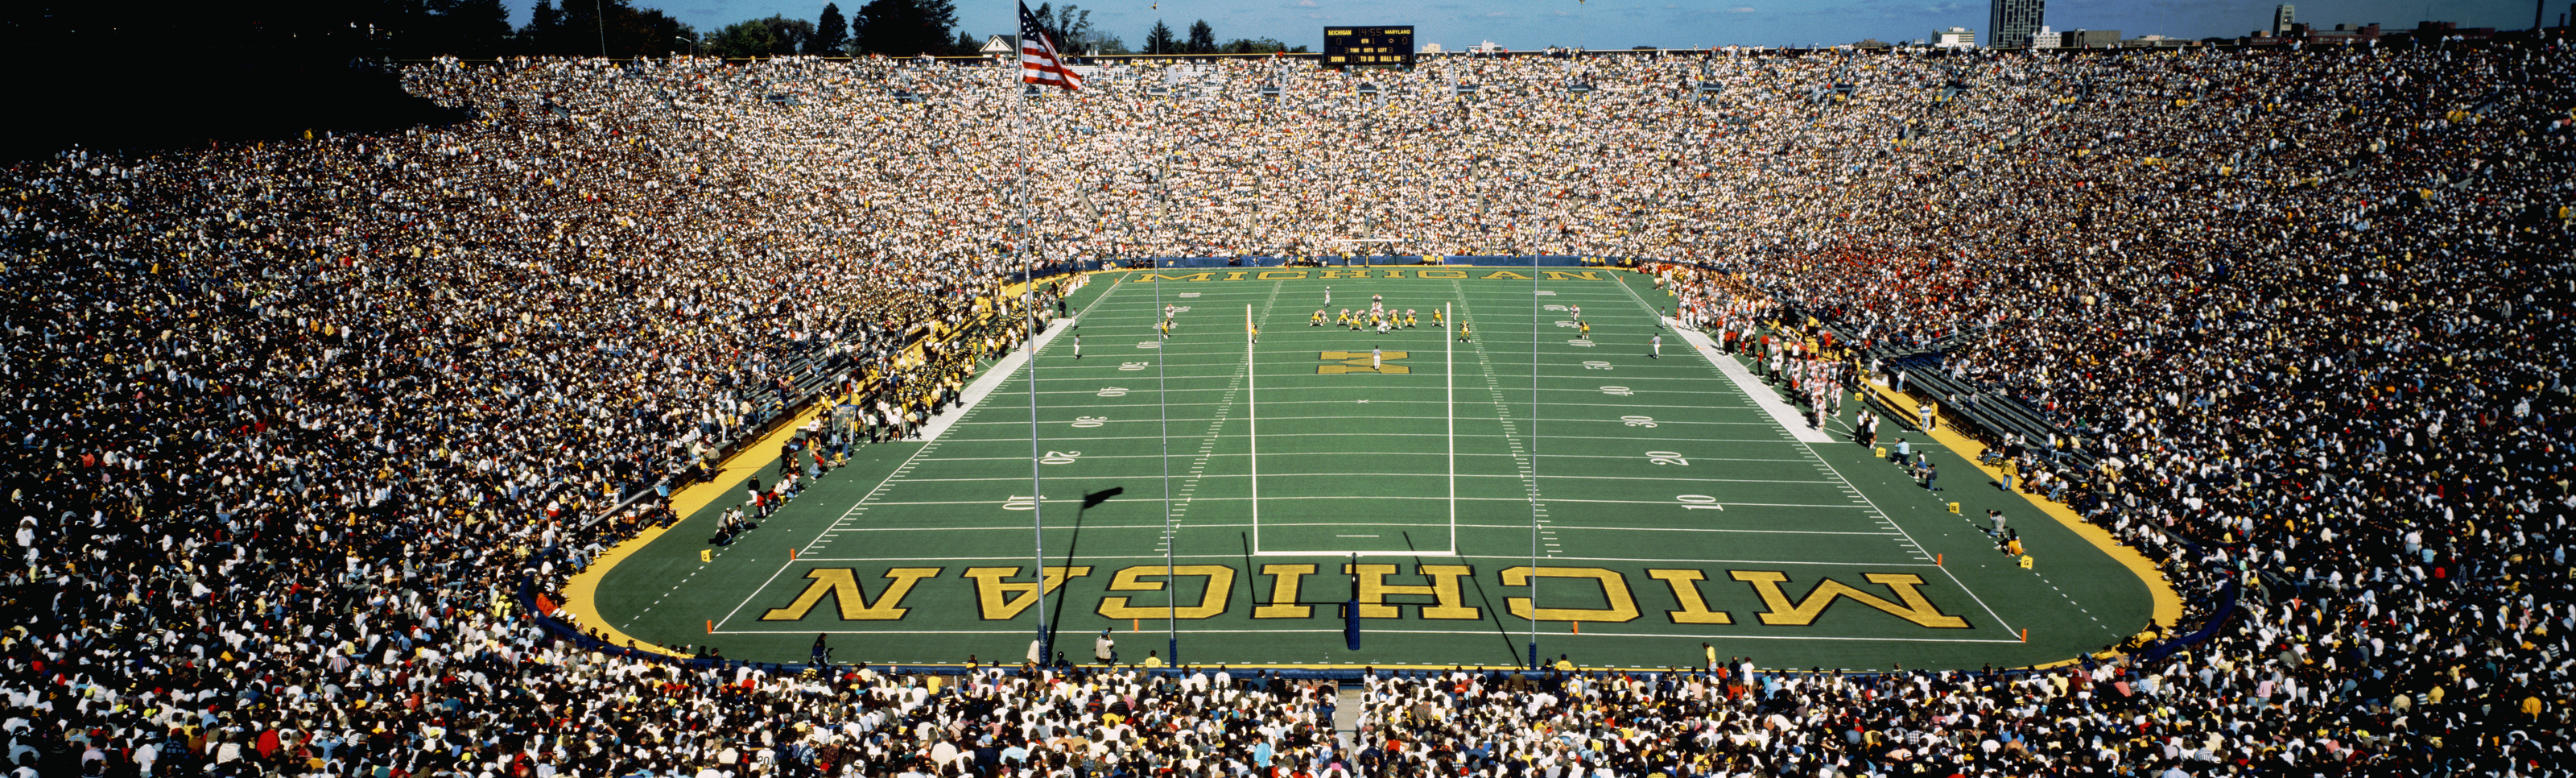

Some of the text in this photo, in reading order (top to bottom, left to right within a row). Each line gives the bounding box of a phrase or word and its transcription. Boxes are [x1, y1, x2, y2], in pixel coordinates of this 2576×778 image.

[1357, 28, 1382, 36] 14:55
[1336, 37, 1342, 45] 0
[1402, 36, 1408, 44] 0
[1350, 55, 1360, 64] 10
[1132, 270, 1601, 283] MICHIGAN
[1118, 362, 1149, 370] 50
[1583, 361, 1614, 370] 50
[1096, 387, 1129, 397] 40
[1600, 386, 1634, 397] 40
[1071, 416, 1108, 428] 30
[1620, 416, 1658, 428] 30
[1039, 450, 1082, 465] 20
[1645, 450, 1690, 466] 20
[1002, 495, 1047, 511] 10
[1676, 495, 1724, 511] 10
[757, 562, 1975, 630] MICHIGAN
